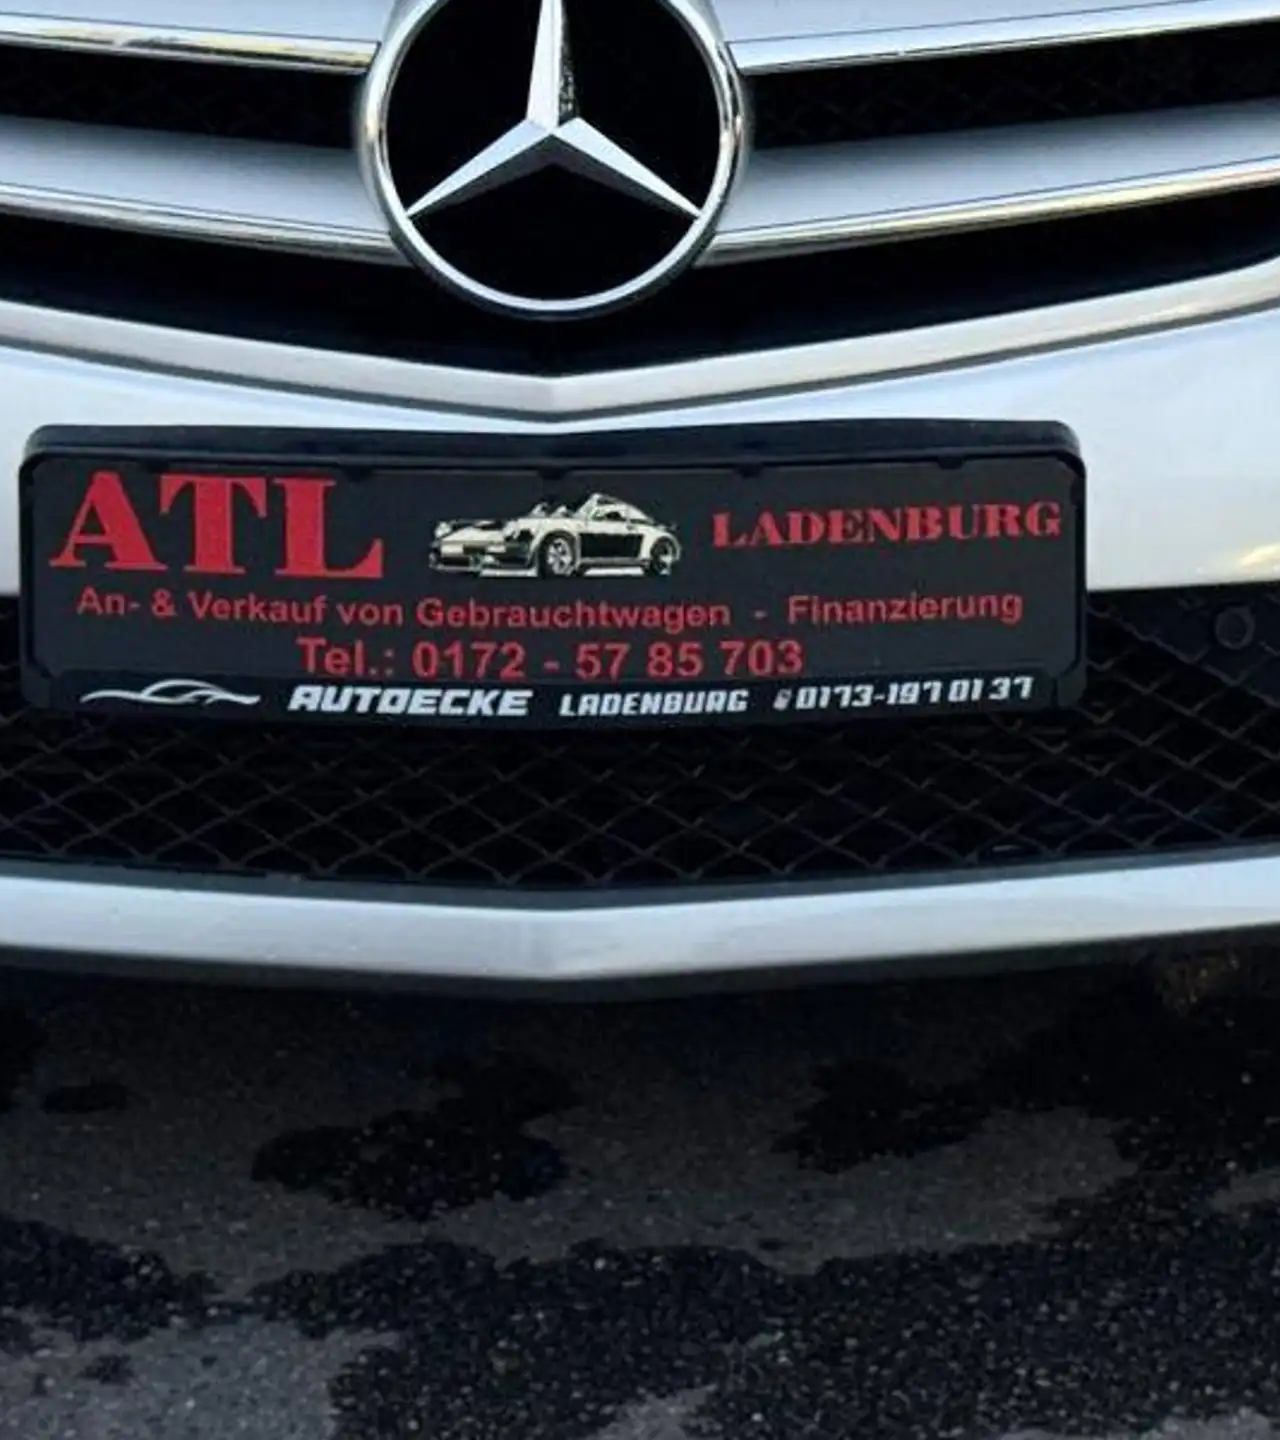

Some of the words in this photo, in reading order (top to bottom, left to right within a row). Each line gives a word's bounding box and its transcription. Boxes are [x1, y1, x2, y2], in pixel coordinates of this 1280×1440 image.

[49, 471, 384, 579] ATL
[712, 500, 1063, 548] LADENBURG
[77, 586, 141, 615] An-
[151, 589, 176, 617] &
[187, 591, 327, 623] Verkauf
[336, 601, 403, 626] von
[418, 597, 731, 634] Gebrauchtwagen
[787, 592, 1023, 625] Finanzierung
[296, 637, 394, 676] Tel.:
[412, 641, 525, 678] 0172
[576, 643, 631, 678] 57
[648, 642, 703, 676] 85
[720, 640, 803, 676] 703
[288, 685, 533, 717] AUTOECKE
[559, 689, 749, 716] LADENBURG
